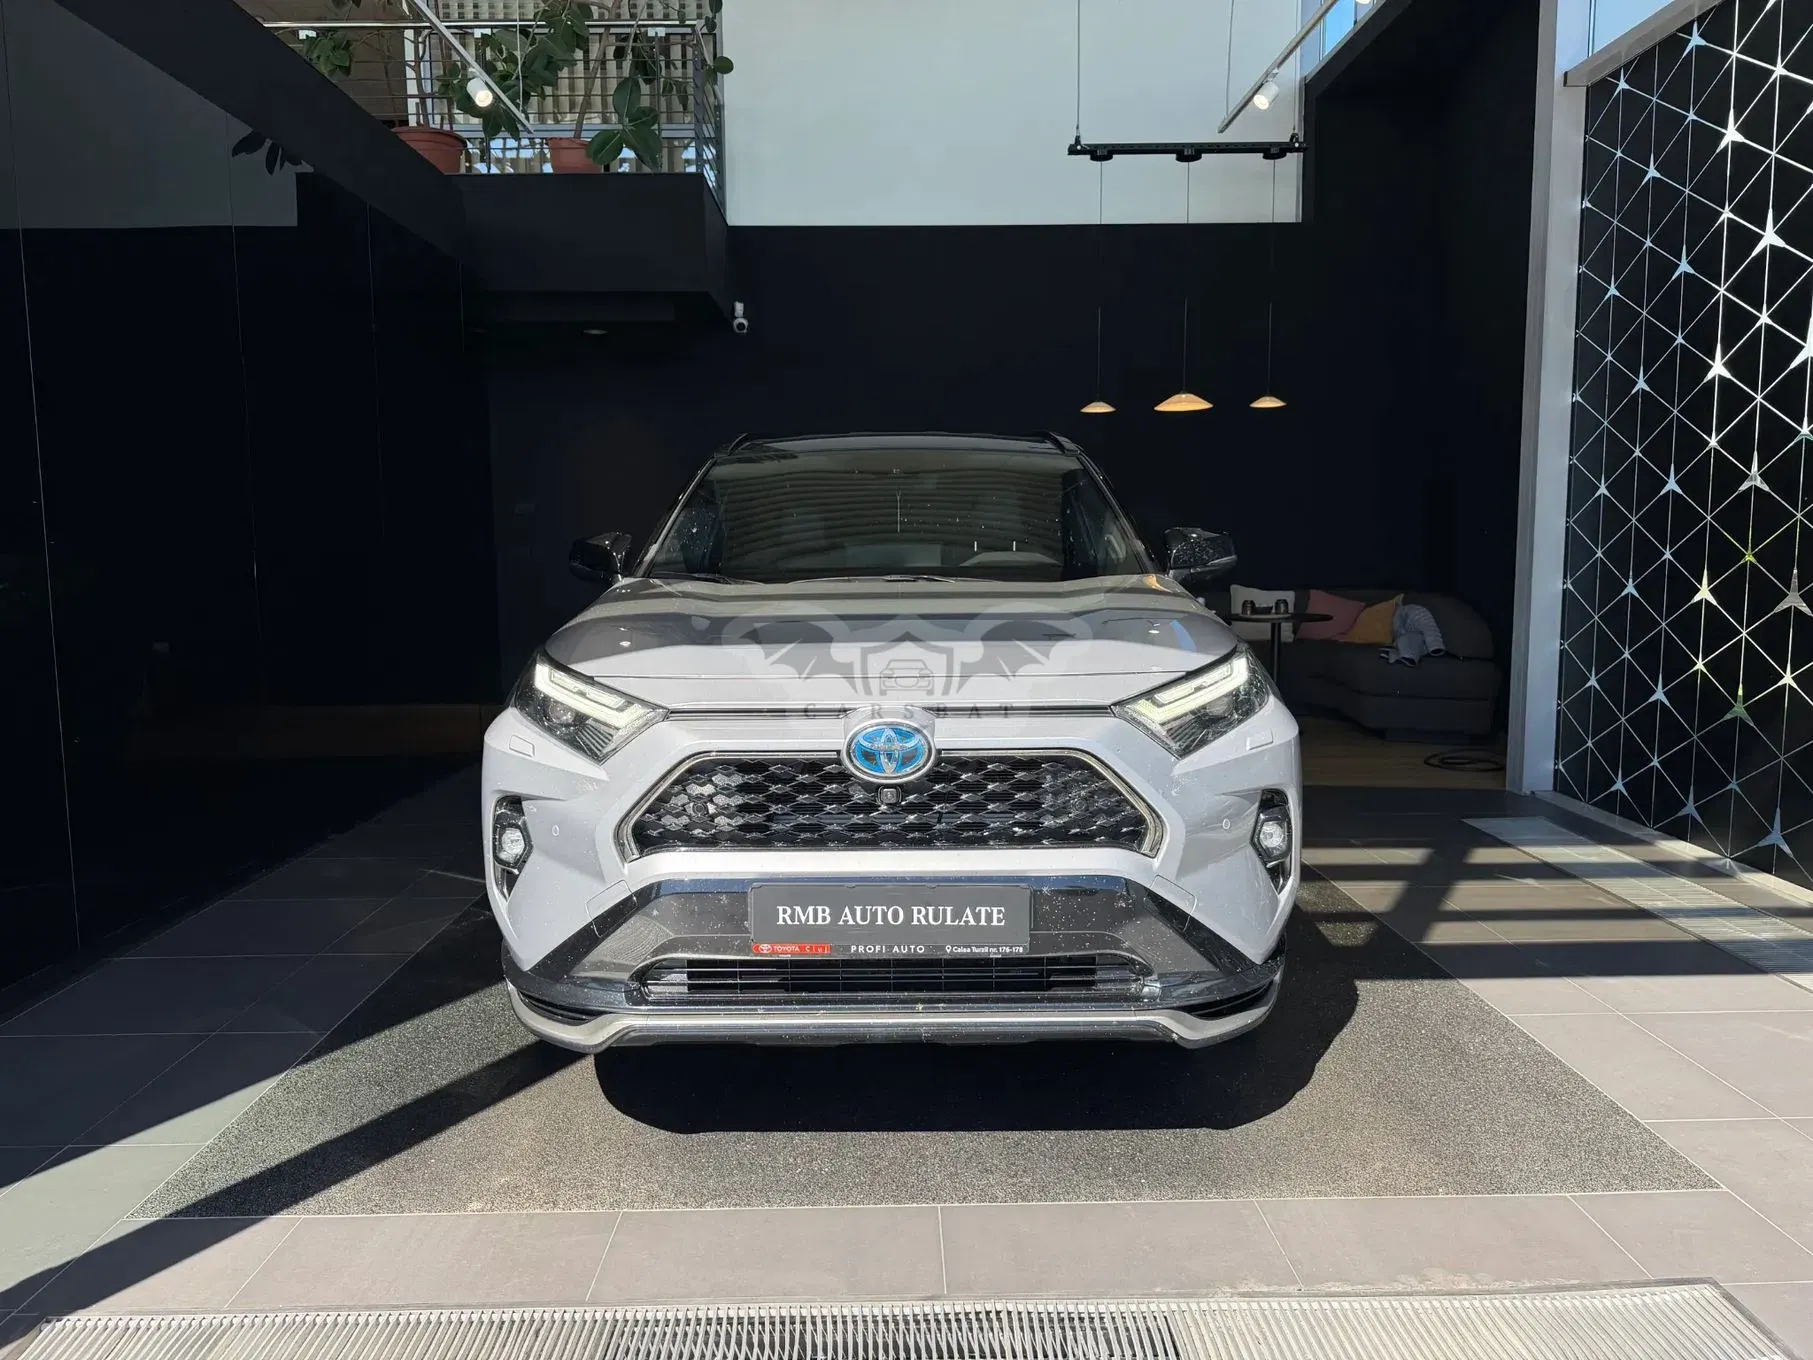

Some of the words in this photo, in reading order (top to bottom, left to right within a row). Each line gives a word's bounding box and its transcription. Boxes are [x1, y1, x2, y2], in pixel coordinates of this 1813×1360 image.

[776, 905, 831, 925] RMB
[838, 906, 904, 926] AUTO
[911, 906, 1005, 926] RULATE
[805, 945, 828, 953] Cluj
[850, 945, 886, 953] PROFI
[892, 945, 925, 953] AUTO
